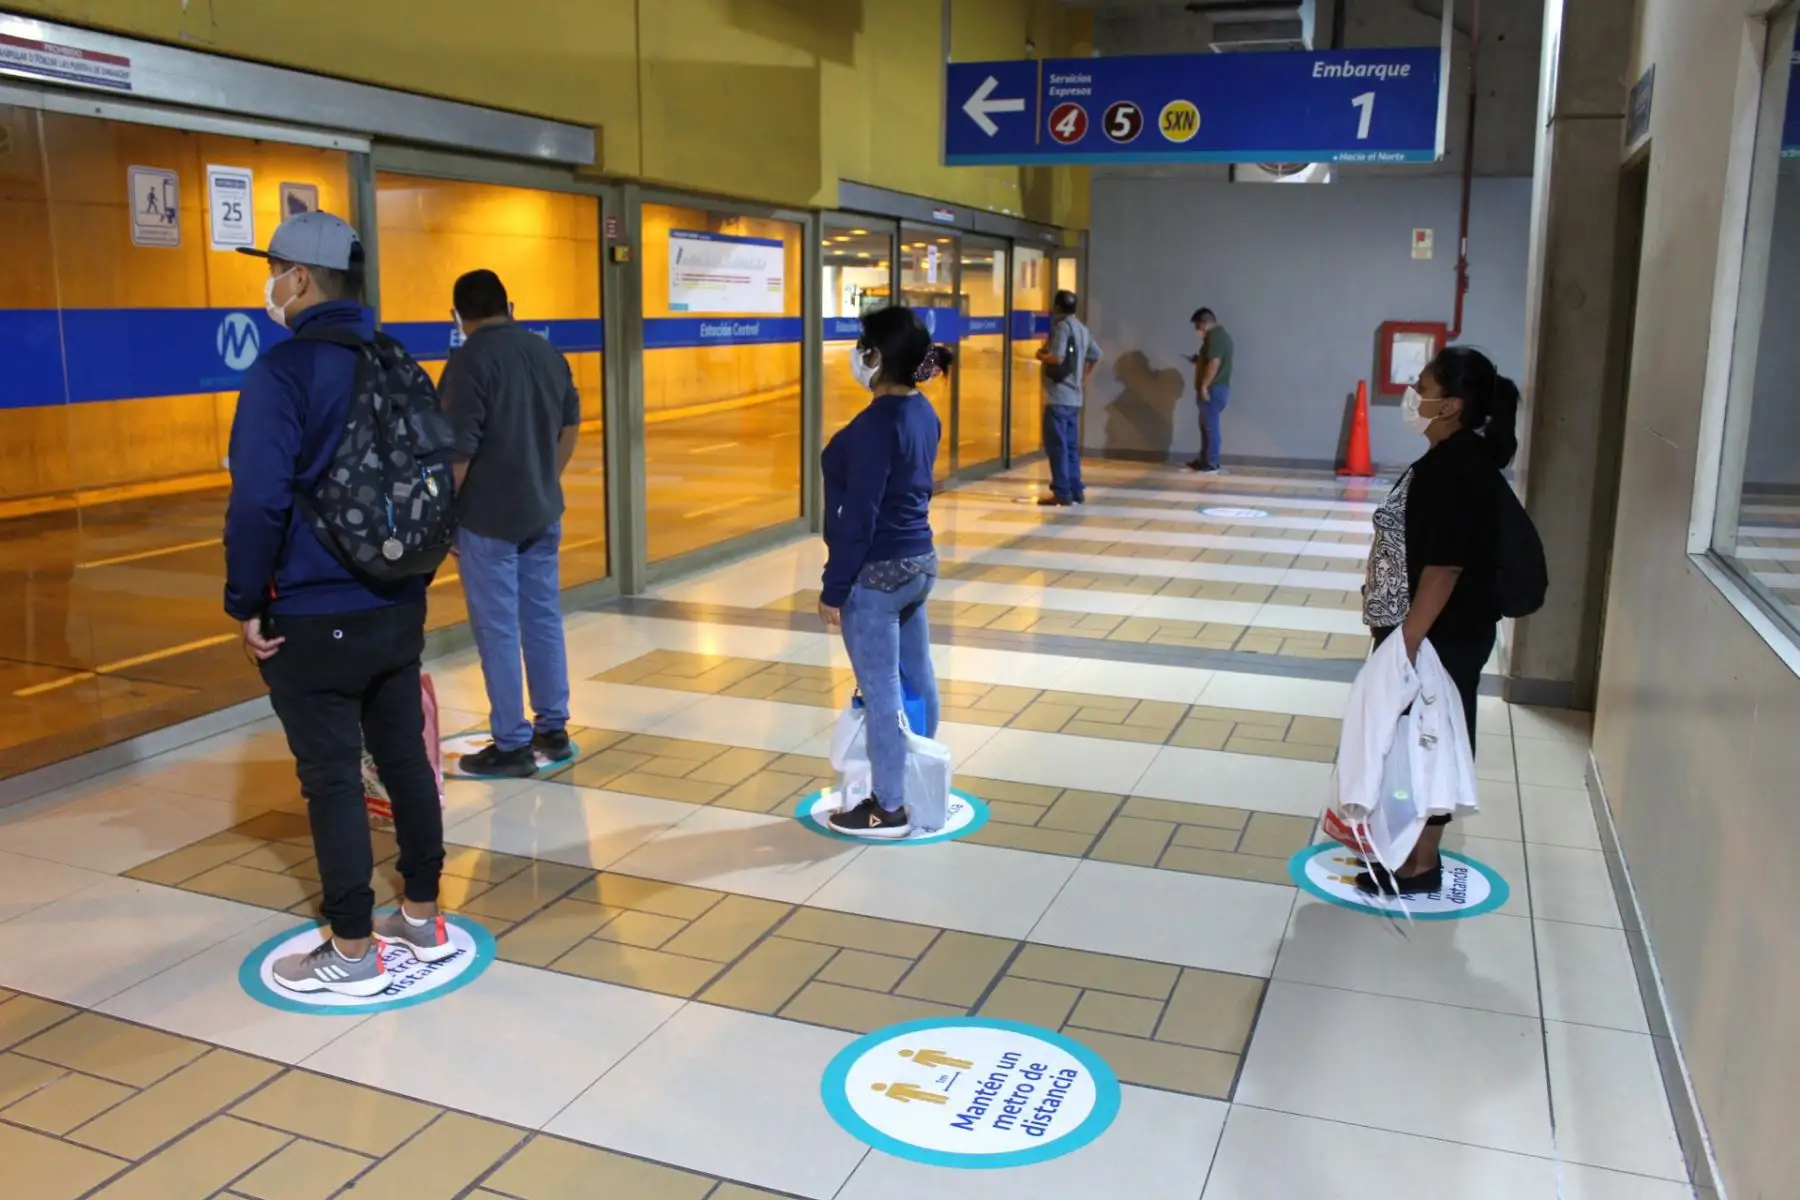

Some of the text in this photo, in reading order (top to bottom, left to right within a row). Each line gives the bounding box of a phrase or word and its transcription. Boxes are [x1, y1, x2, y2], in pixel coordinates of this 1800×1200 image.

[1049, 73, 1092, 84] Servicios
[1312, 60, 1412, 81] Embarque
[1049, 87, 1092, 98] Expresos
[1055, 107, 1196, 137] 4 5 SXN
[1351, 91, 1376, 140] 1
[1339, 152, 1405, 161] Hacia el Norte
[221, 202, 243, 222] 25
[1446, 868, 1468, 904] distancia
[950, 1051, 1022, 1131] Mantén un
[992, 1062, 1048, 1130] metro de
[1020, 1068, 1078, 1137] distancia
